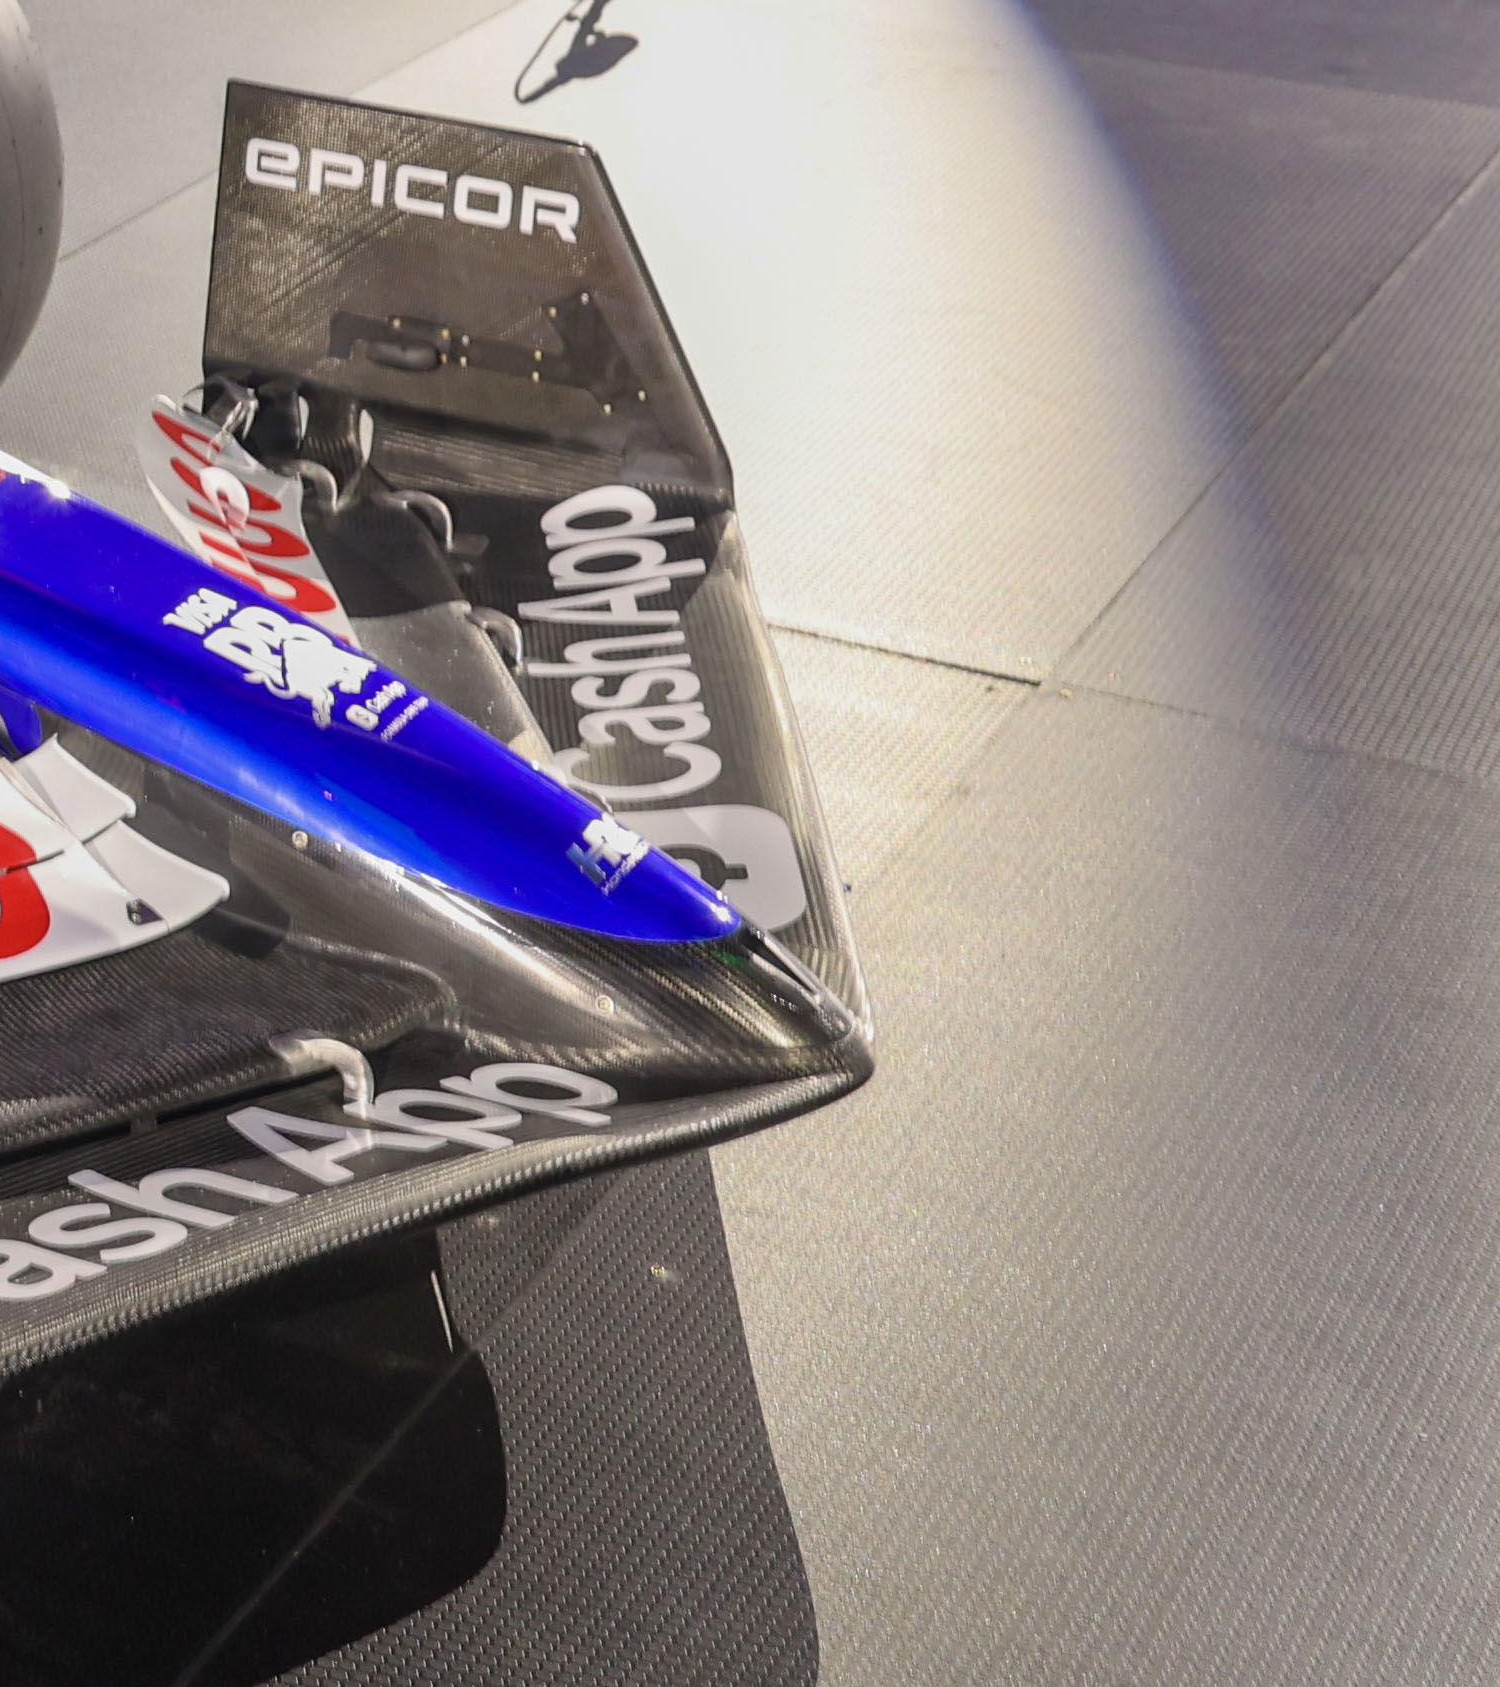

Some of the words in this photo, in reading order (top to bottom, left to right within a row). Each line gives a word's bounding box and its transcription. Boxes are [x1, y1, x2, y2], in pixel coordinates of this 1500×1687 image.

[516, 484, 707, 626] App
[526, 629, 723, 802] Cash
[225, 1061, 619, 1185] App
